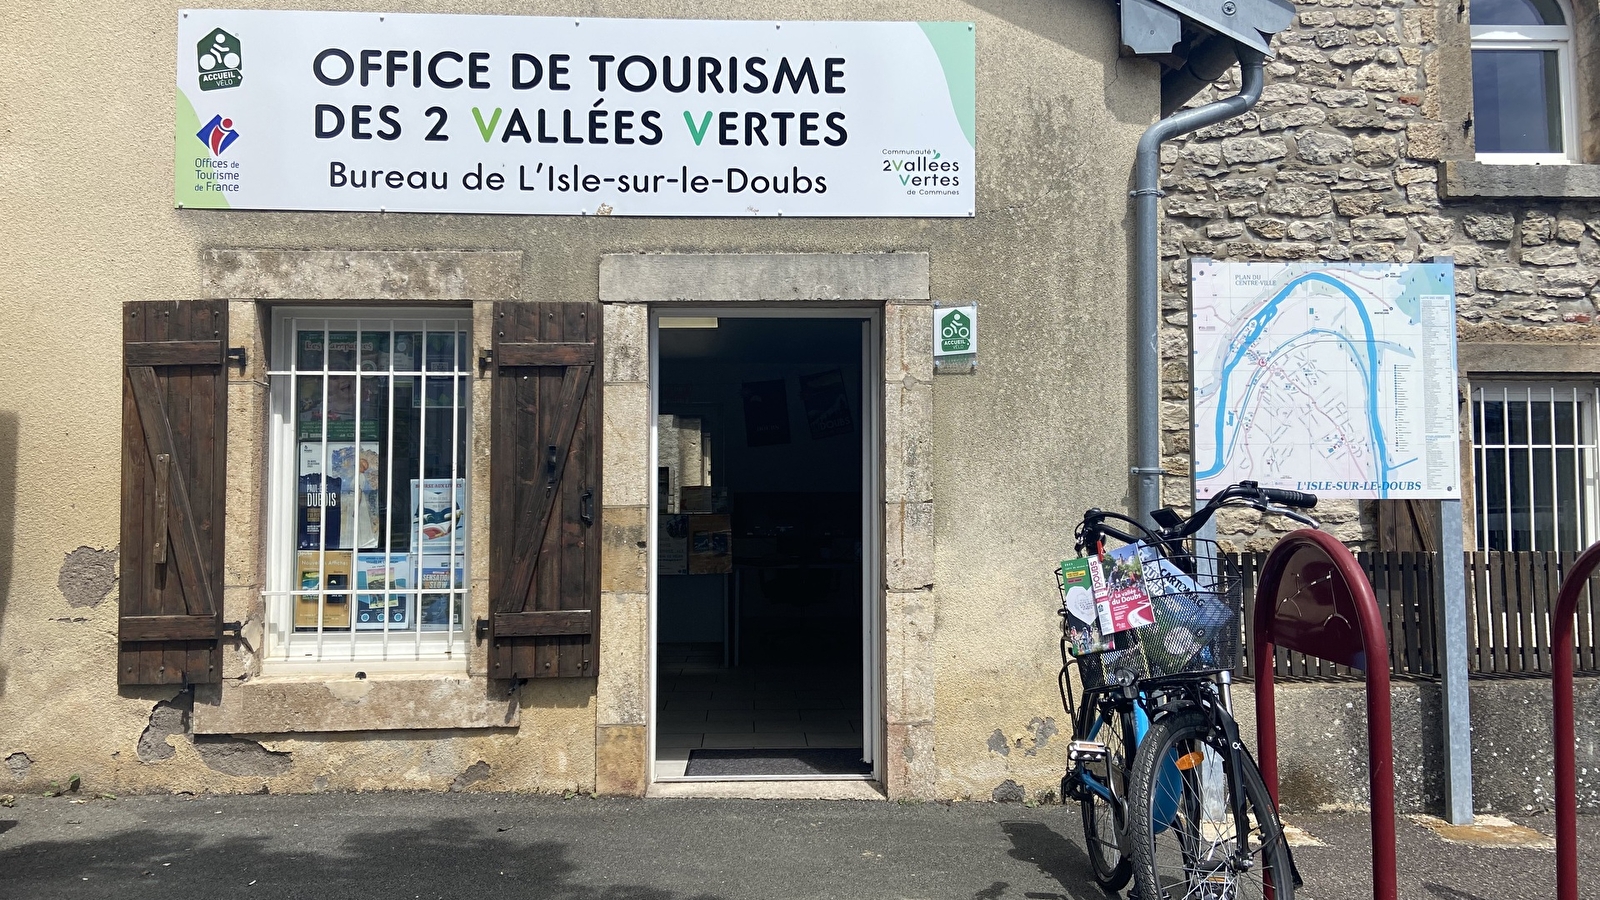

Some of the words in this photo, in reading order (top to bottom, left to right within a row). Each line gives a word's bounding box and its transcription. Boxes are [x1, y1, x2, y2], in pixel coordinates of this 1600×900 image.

[202, 71, 236, 82] ACCUEIL
[313, 48, 490, 89] OFFICE
[512, 53, 570, 91] DE
[589, 55, 846, 94] TOURISME
[216, 78, 233, 87] VÉLO
[314, 104, 402, 140] DES
[424, 106, 449, 142] 2
[472, 98, 663, 145] VALLÉES
[683, 110, 848, 146] VERTES
[194, 158, 228, 169] Offices
[230, 160, 240, 169] de
[195, 170, 240, 180] Tourisme
[330, 162, 448, 190] Bureau
[462, 163, 505, 191] de
[520, 162, 827, 194] L'Isle-sur-le-Doubs
[900, 174, 960, 187] Vertes
[194, 182, 204, 192] de
[206, 181, 240, 192] France
[820, 416, 851, 430] DOUBS
[1296, 480, 1422, 491] L'ISLE-SUR-LE-DOUBS
[1090, 560, 1102, 588] DOUBS
[1122, 593, 1142, 603] Doubs
